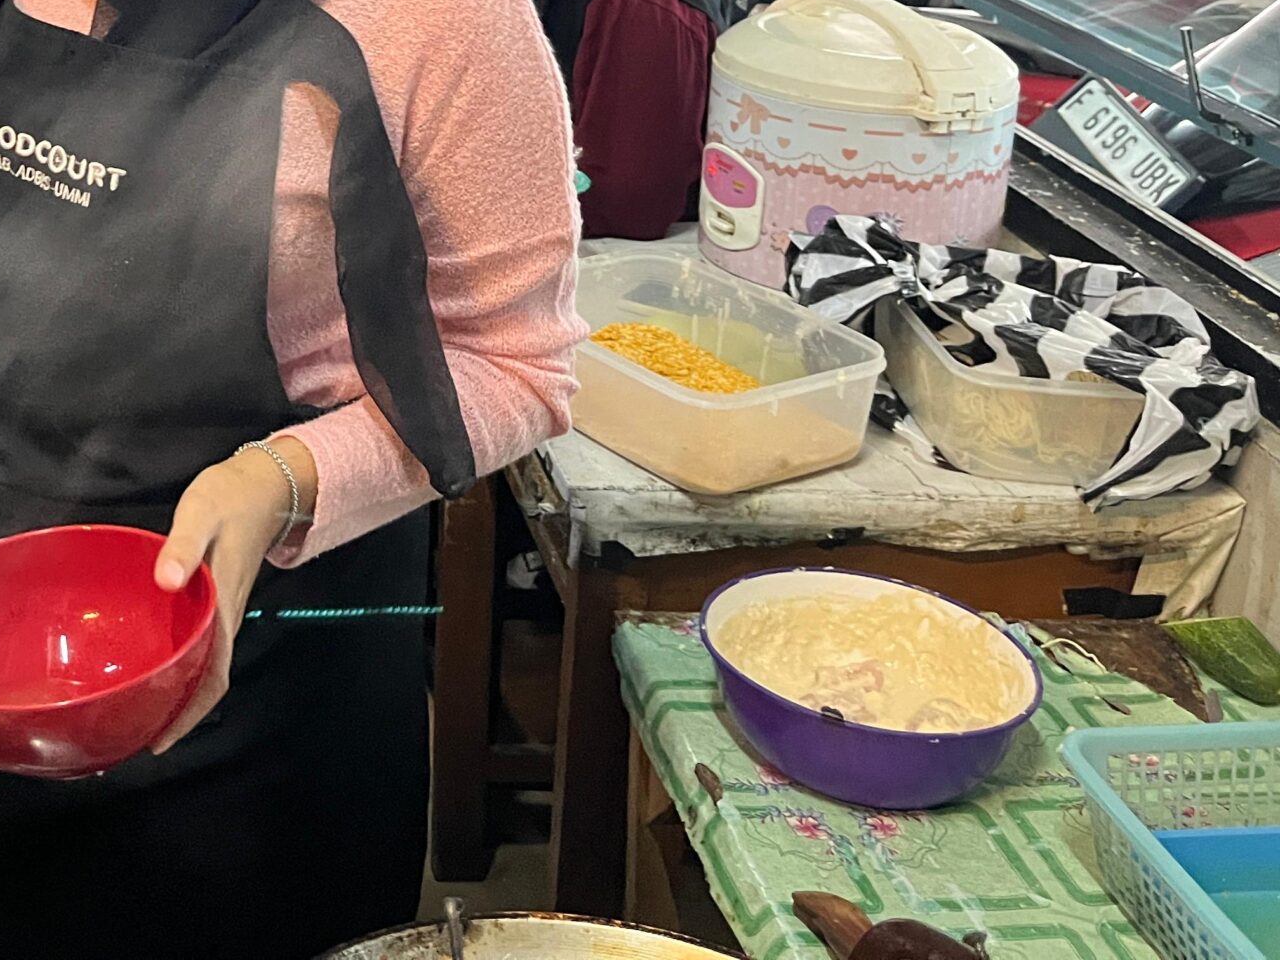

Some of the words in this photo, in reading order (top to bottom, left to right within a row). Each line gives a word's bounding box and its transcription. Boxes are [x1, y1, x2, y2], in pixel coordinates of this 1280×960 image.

[1065, 88, 1094, 111] F
[1082, 106, 1138, 160] 6196
[1130, 151, 1181, 203] UBK
